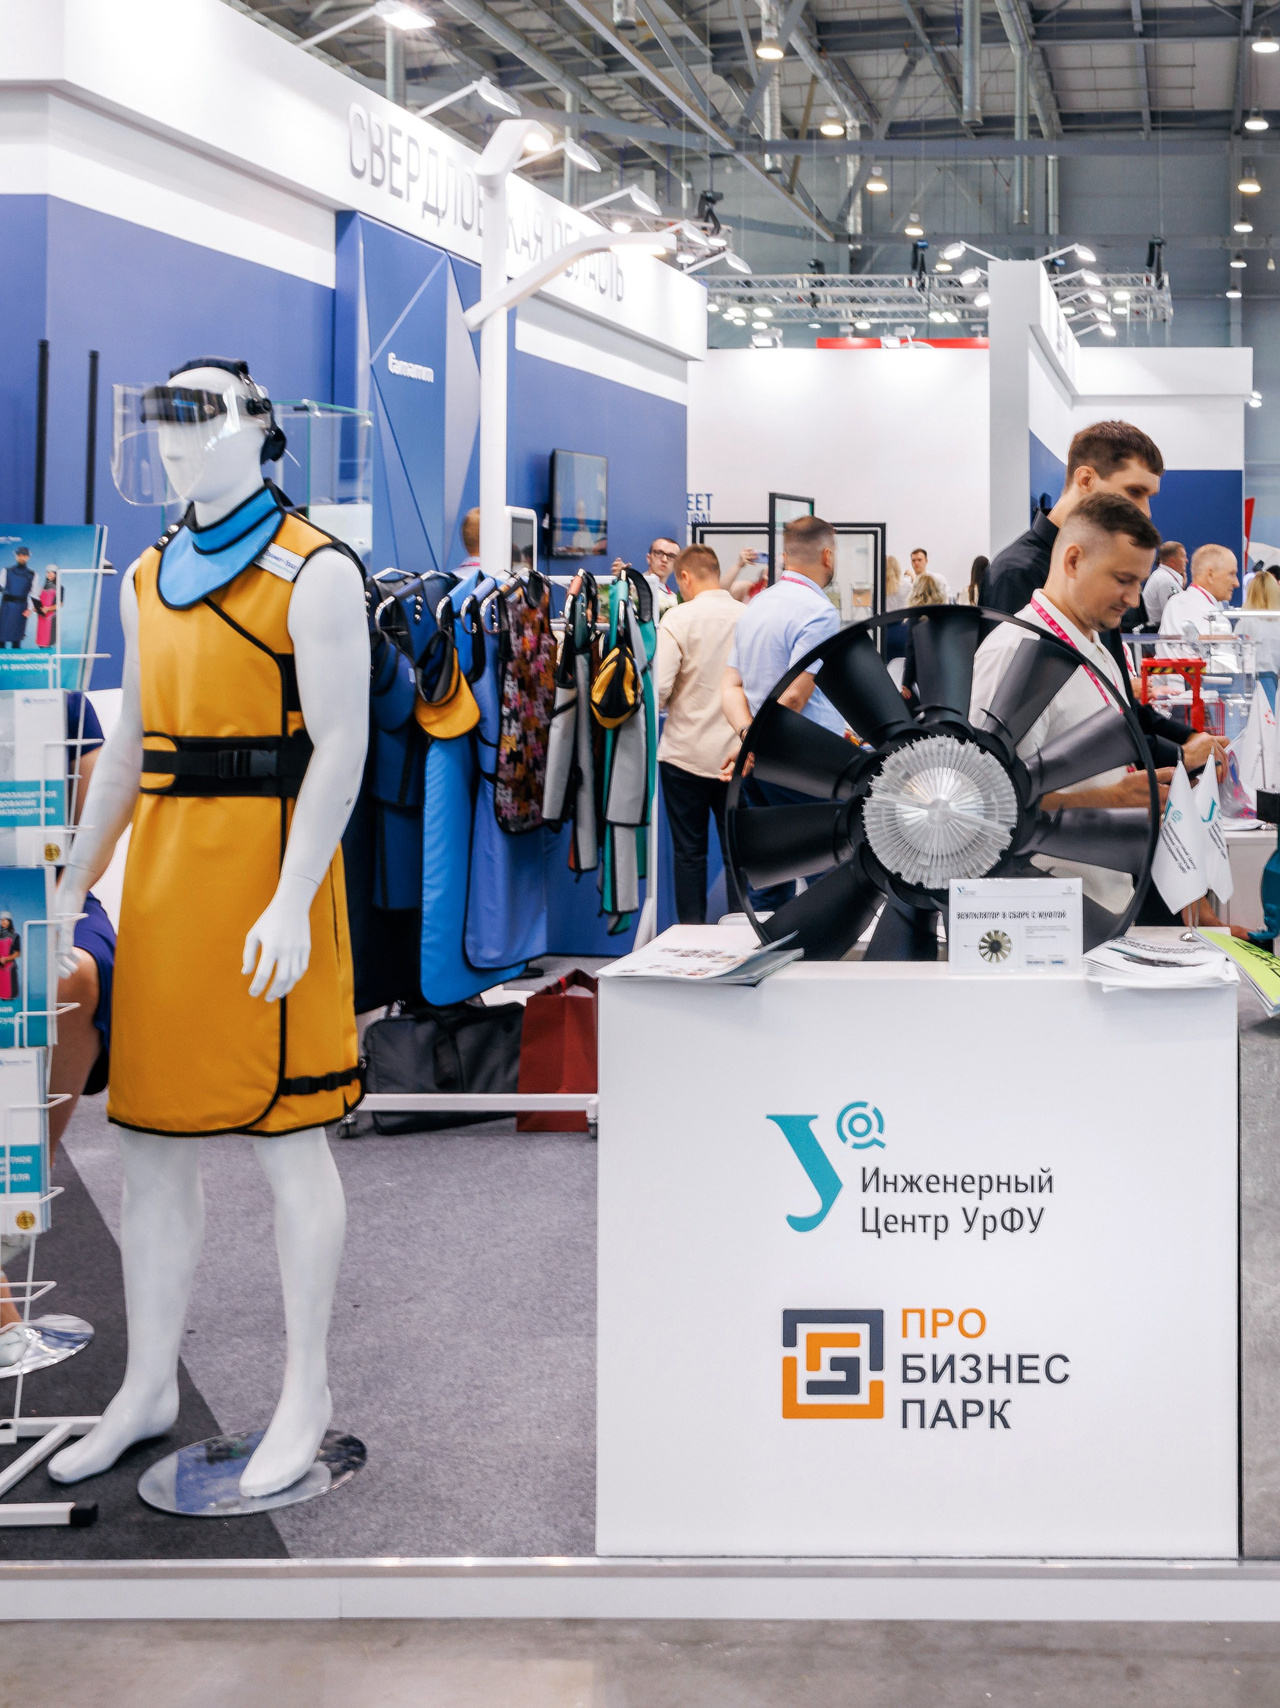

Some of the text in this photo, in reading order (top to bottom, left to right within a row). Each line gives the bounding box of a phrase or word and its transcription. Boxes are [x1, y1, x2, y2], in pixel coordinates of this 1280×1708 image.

[860, 1165, 1053, 1201] Инженерный
[860, 1206, 1045, 1241] Центр УрФУ
[901, 1307, 987, 1339] ПРО
[901, 1353, 1071, 1385] БИЗНЕС
[901, 1399, 1011, 1430] ПАРК
